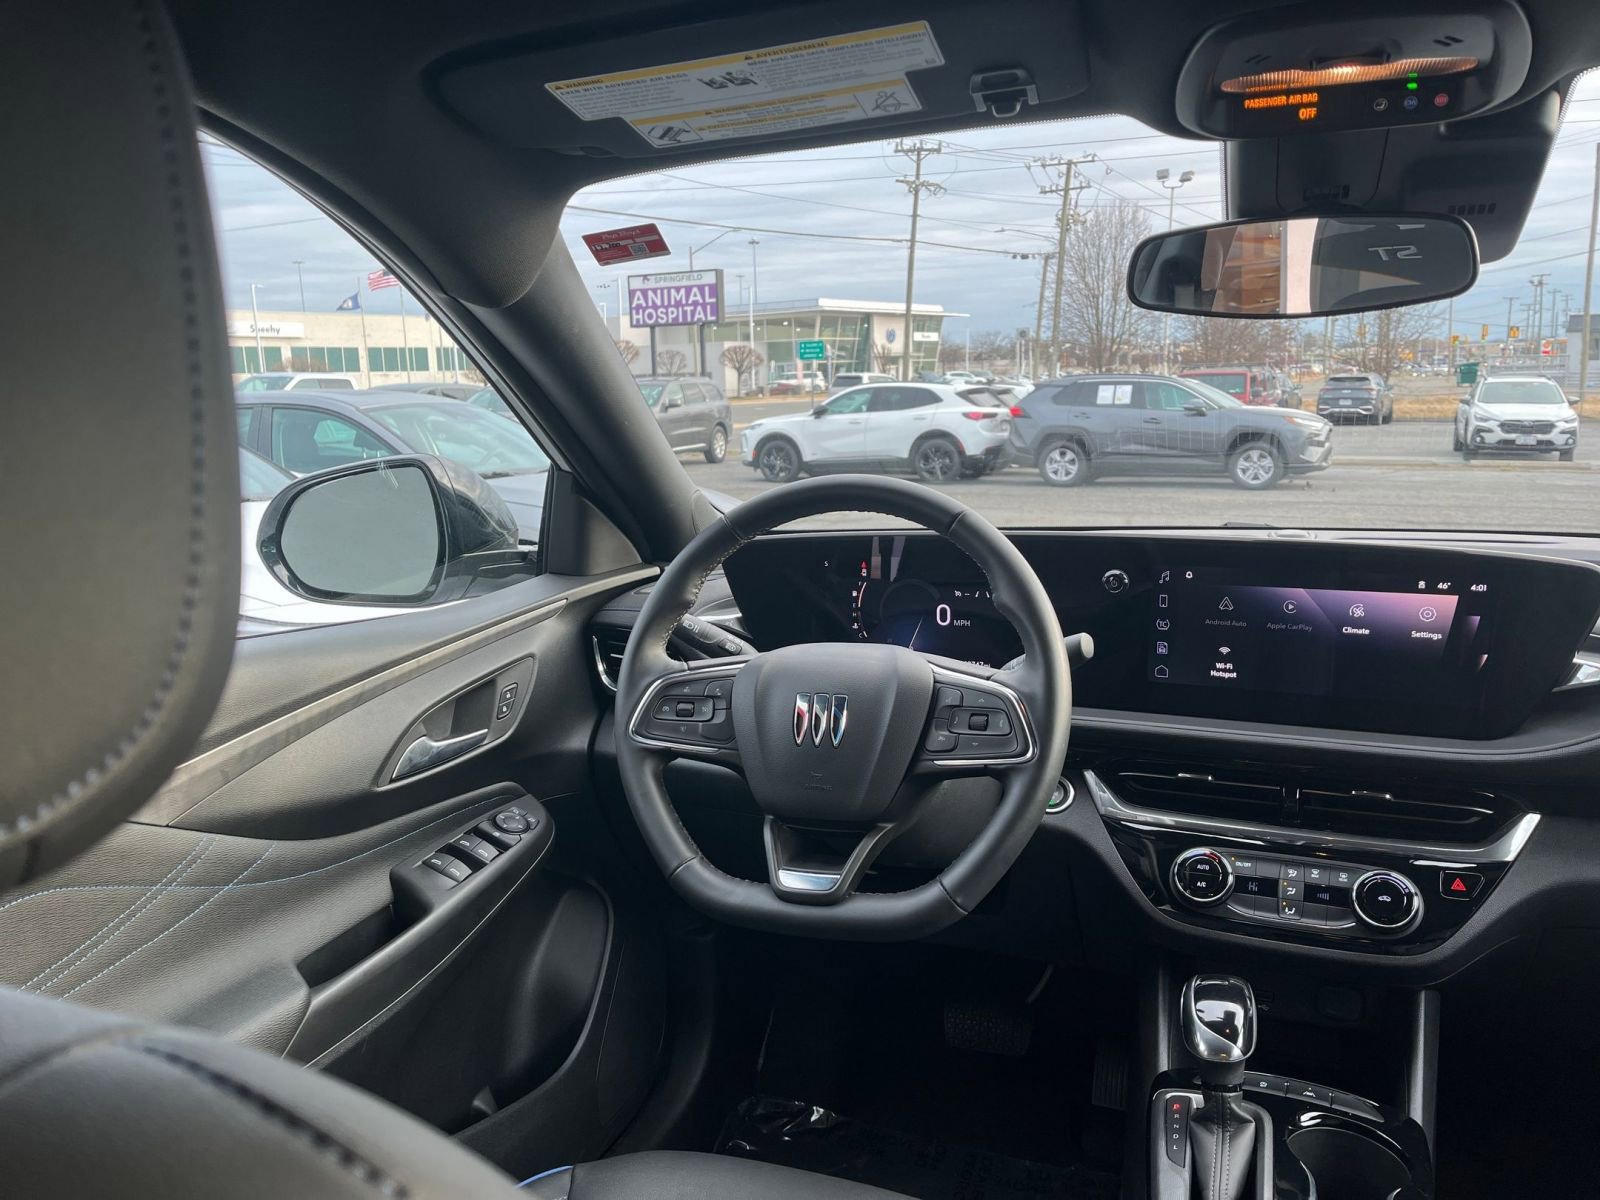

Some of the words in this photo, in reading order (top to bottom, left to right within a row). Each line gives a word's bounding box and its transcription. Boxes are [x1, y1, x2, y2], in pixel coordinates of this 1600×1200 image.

[565, 78, 603, 88] WARNING
[1244, 95, 1286, 109] PASSENGER
[1288, 94, 1302, 105] AIR
[1302, 92, 1318, 103] BAG
[1299, 107, 1317, 120] OFF
[654, 273, 703, 284] SPRINGFIELD
[632, 285, 717, 308] ANIMAL
[632, 305, 717, 325] HOSPITAL
[1470, 584, 1487, 592] 4:01
[936, 603, 951, 626] 0
[953, 619, 971, 628] MPH
[1204, 618, 1231, 626] Android
[1231, 619, 1247, 627] Auto
[1266, 621, 1286, 630] Apple
[1287, 623, 1313, 632] CarPlay
[1342, 626, 1370, 635] Climate
[1411, 630, 1442, 640] Settings
[1215, 662, 1233, 670] Wi-Fi
[1210, 670, 1237, 679] Hotspot
